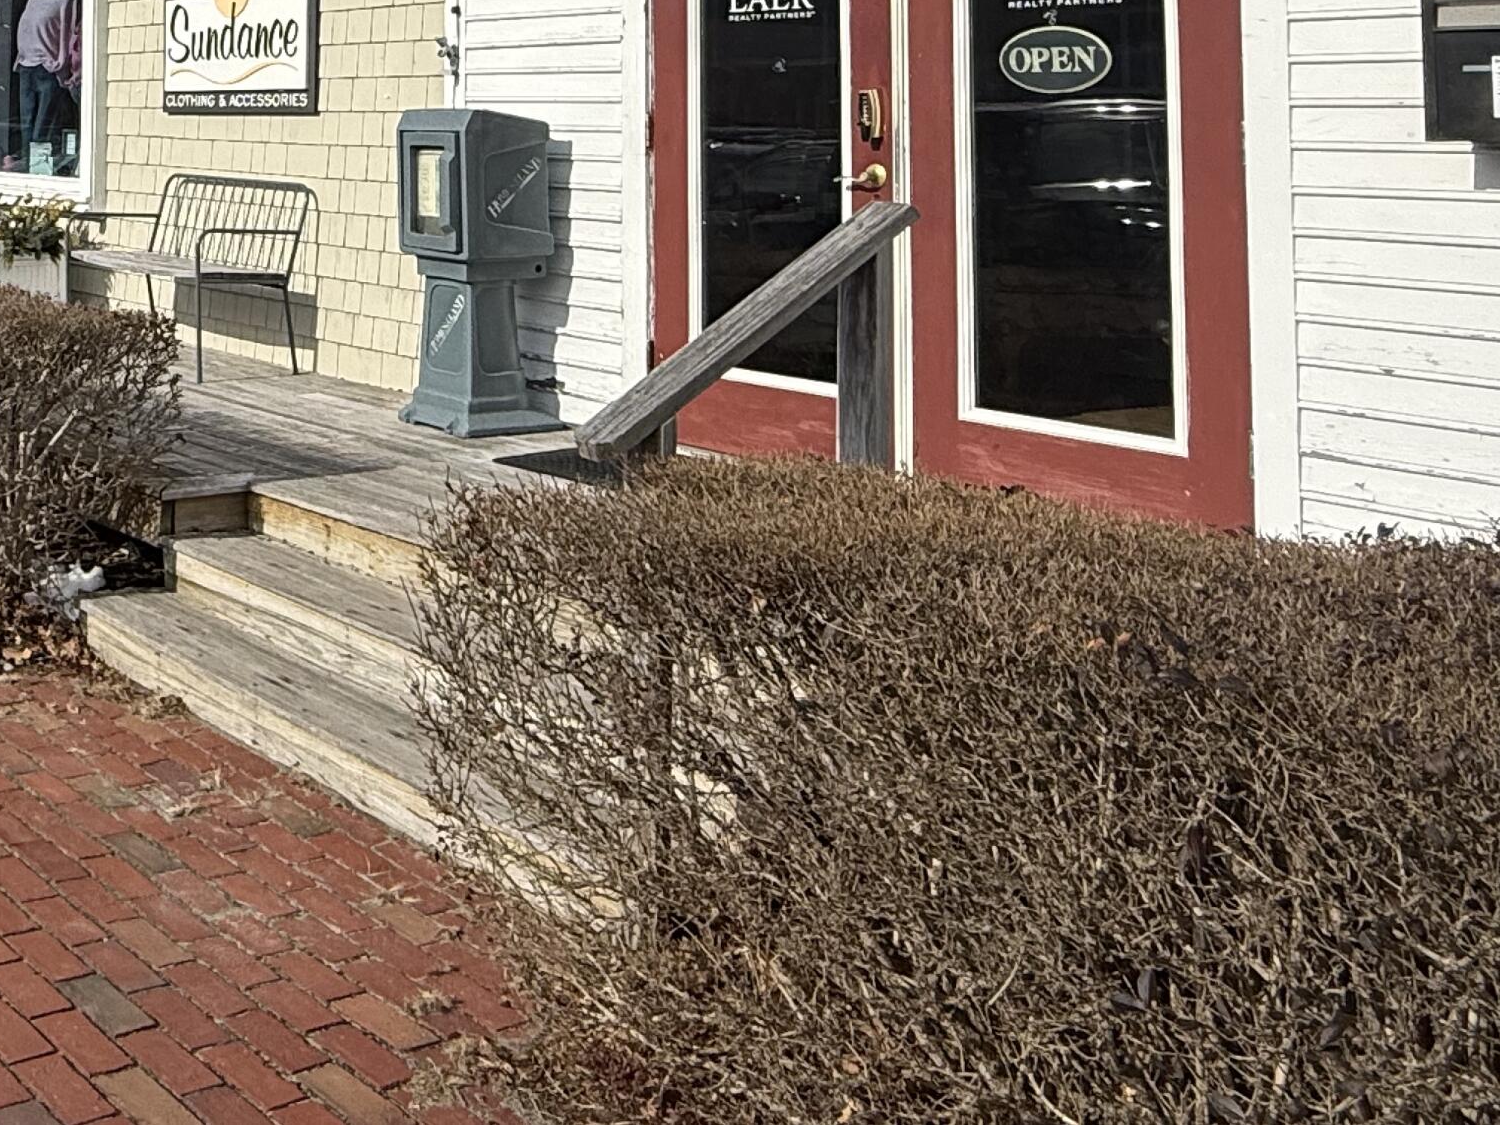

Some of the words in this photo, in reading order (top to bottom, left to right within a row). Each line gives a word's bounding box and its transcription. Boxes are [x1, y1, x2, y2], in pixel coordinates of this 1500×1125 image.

[1008, 0, 1052, 9] REALTY
[728, 14, 761, 22] REALTY
[168, 2, 299, 63] Sundance
[1008, 46, 1097, 73] OPEN
[165, 94, 216, 108] CLOTHING
[219, 94, 228, 107] &
[228, 92, 308, 107] ACCESSORIES
